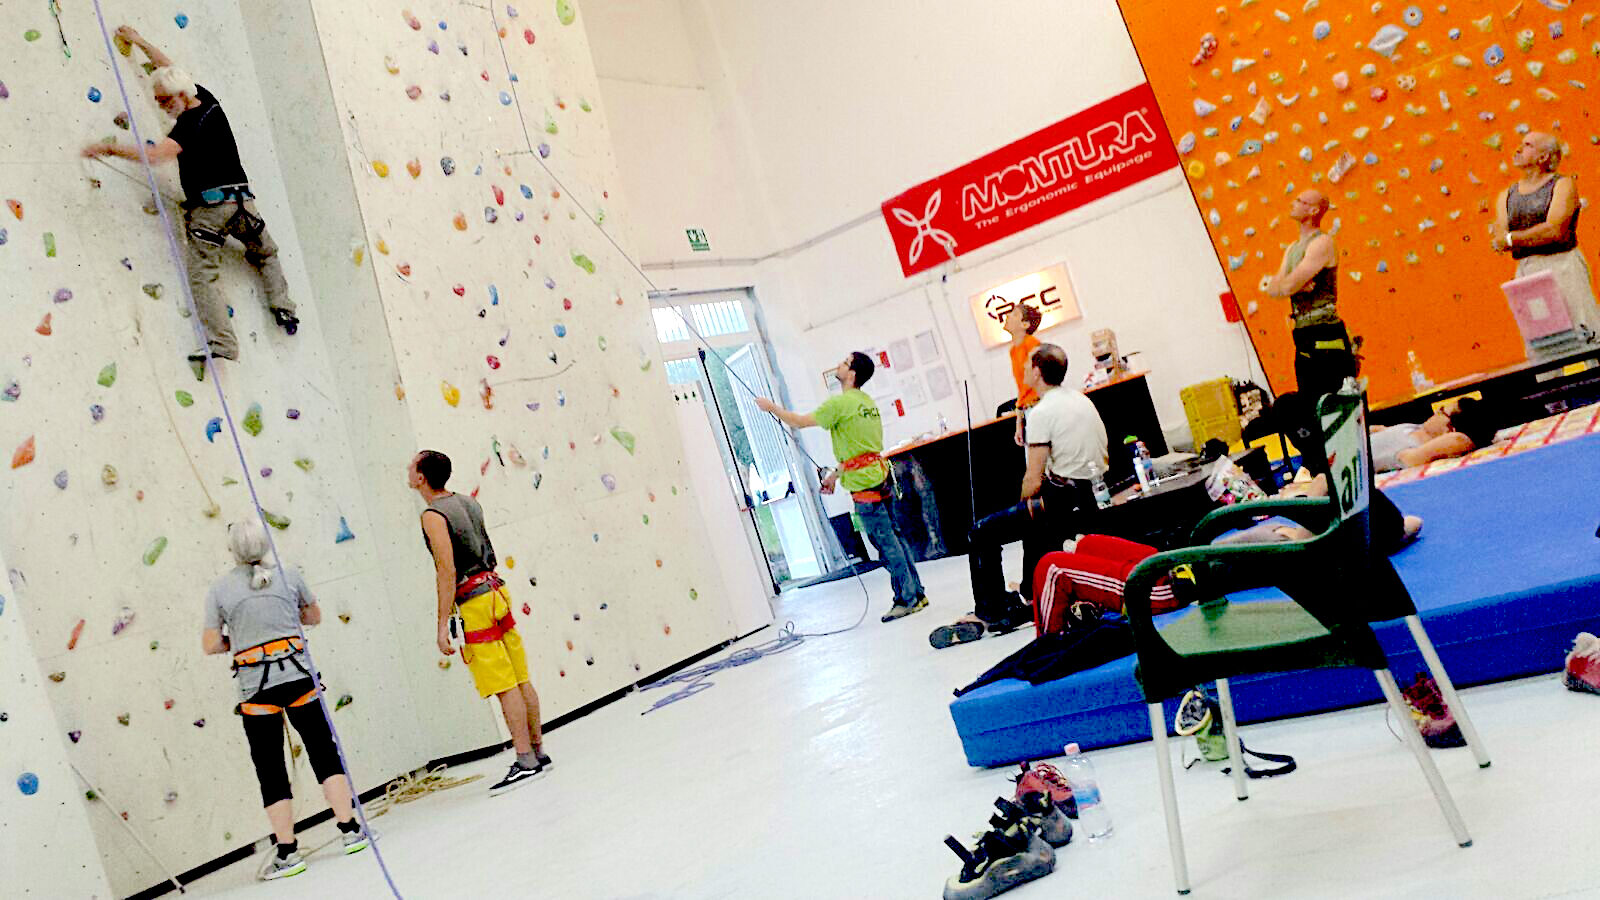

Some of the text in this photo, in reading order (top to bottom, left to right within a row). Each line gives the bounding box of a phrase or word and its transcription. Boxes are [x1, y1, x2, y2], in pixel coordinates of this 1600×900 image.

[962, 110, 1157, 221] MONTURA
[975, 150, 1153, 230] The Ergonomic Equipage
